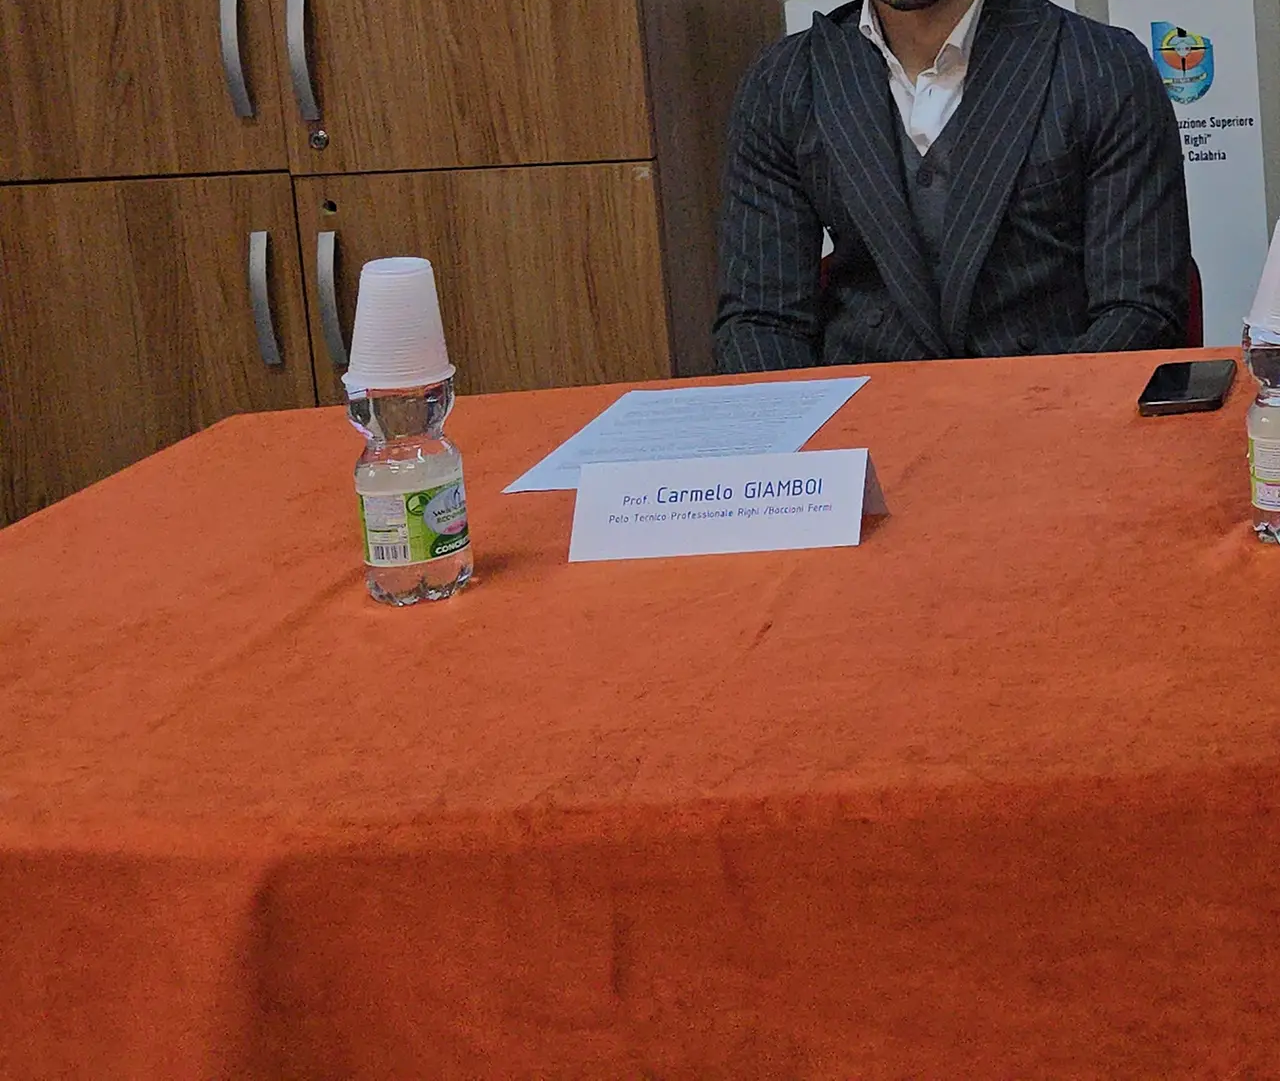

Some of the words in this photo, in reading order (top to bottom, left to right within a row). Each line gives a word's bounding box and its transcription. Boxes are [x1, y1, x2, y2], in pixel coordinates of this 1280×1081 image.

[1210, 116, 1254, 130] Superiore
[1184, 134, 1212, 147] Righi"
[1188, 150, 1227, 162] Calabria
[622, 494, 650, 507] Prof.
[656, 484, 734, 504] Carmelo
[744, 478, 823, 500] GIAMBOI
[608, 514, 630, 524] Polo
[634, 512, 668, 523] Tecnico
[670, 508, 734, 521] Professionale
[737, 506, 760, 520] Righi
[763, 504, 804, 516] /Boccioni
[808, 503, 832, 514] Fermi
